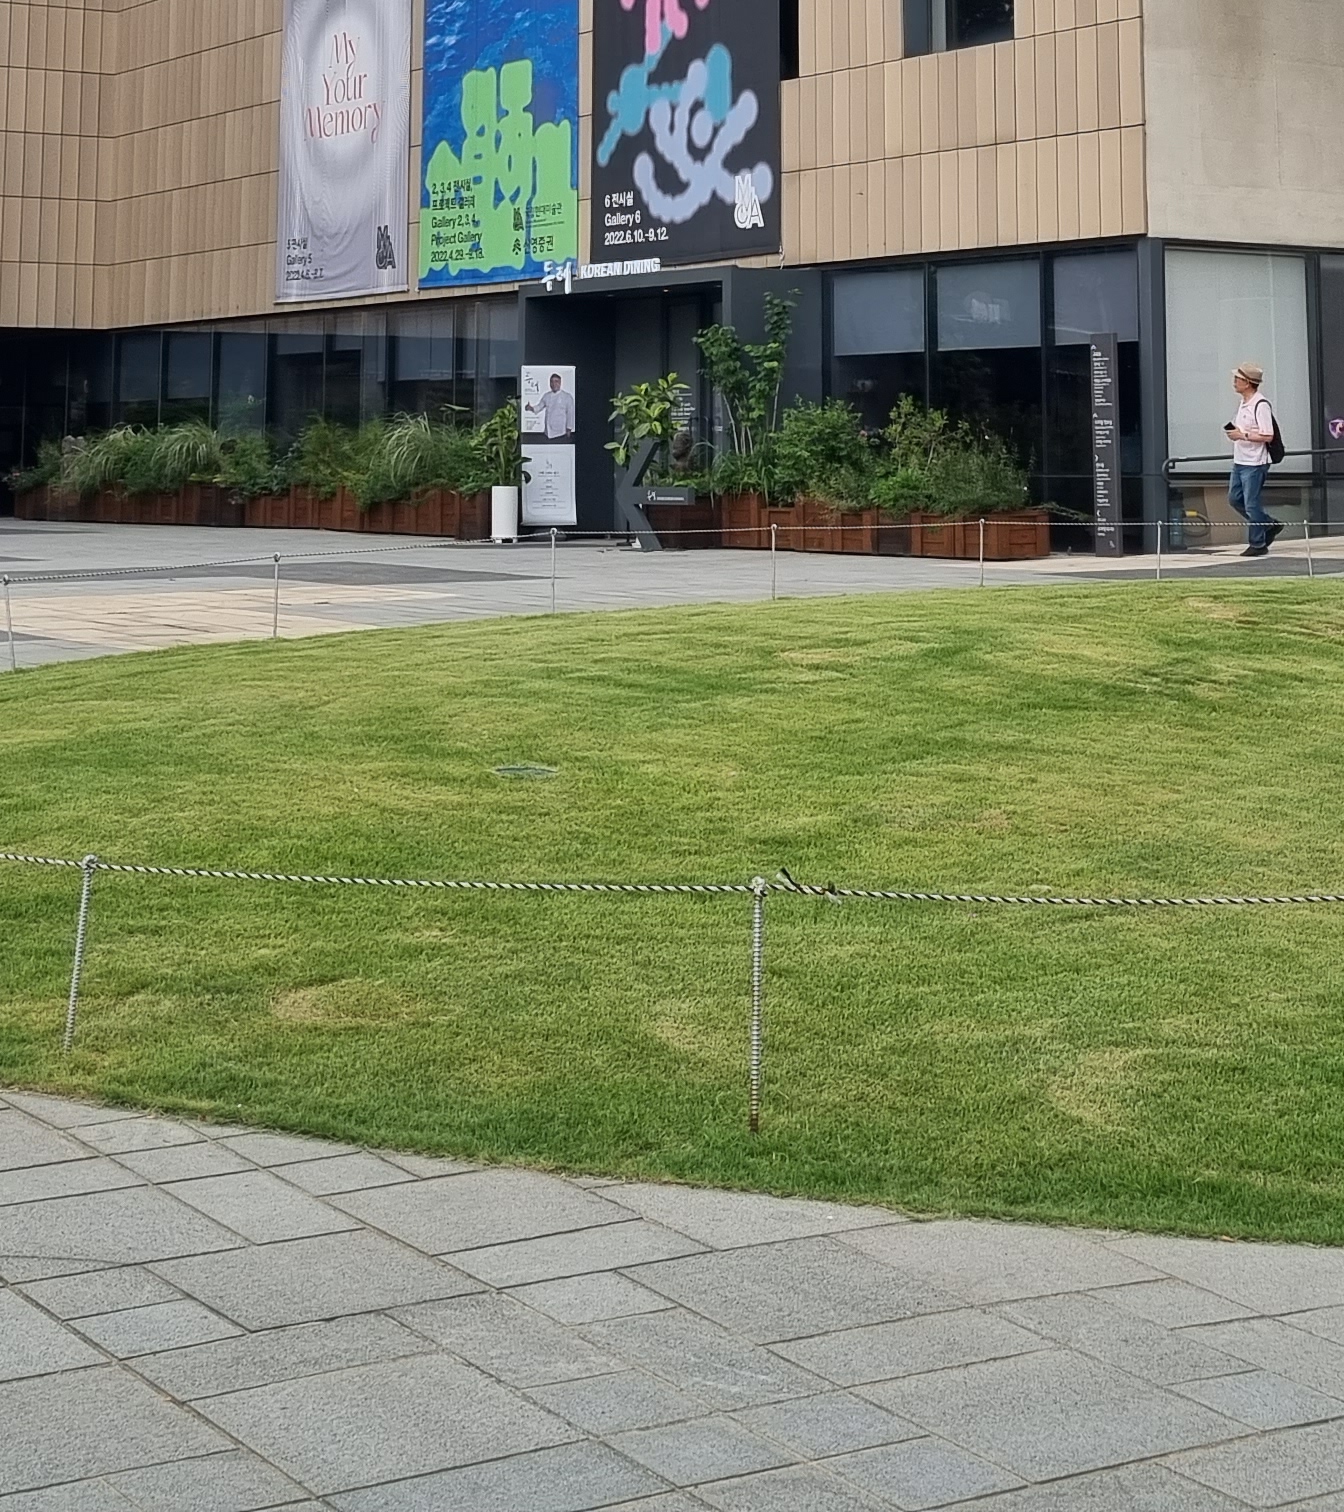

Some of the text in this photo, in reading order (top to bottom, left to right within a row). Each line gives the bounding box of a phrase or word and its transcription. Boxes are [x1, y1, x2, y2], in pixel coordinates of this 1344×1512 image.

[329, 32, 360, 80] My
[322, 72, 367, 105] Your
[304, 100, 385, 144] Memory
[605, 191, 634, 208] 6 전시실
[432, 216, 456, 229] Gallery
[605, 210, 641, 227] Gallery 6
[431, 231, 483, 247] Project Gallery
[581, 261, 623, 279] KOREAN
[623, 257, 661, 276] DINING
